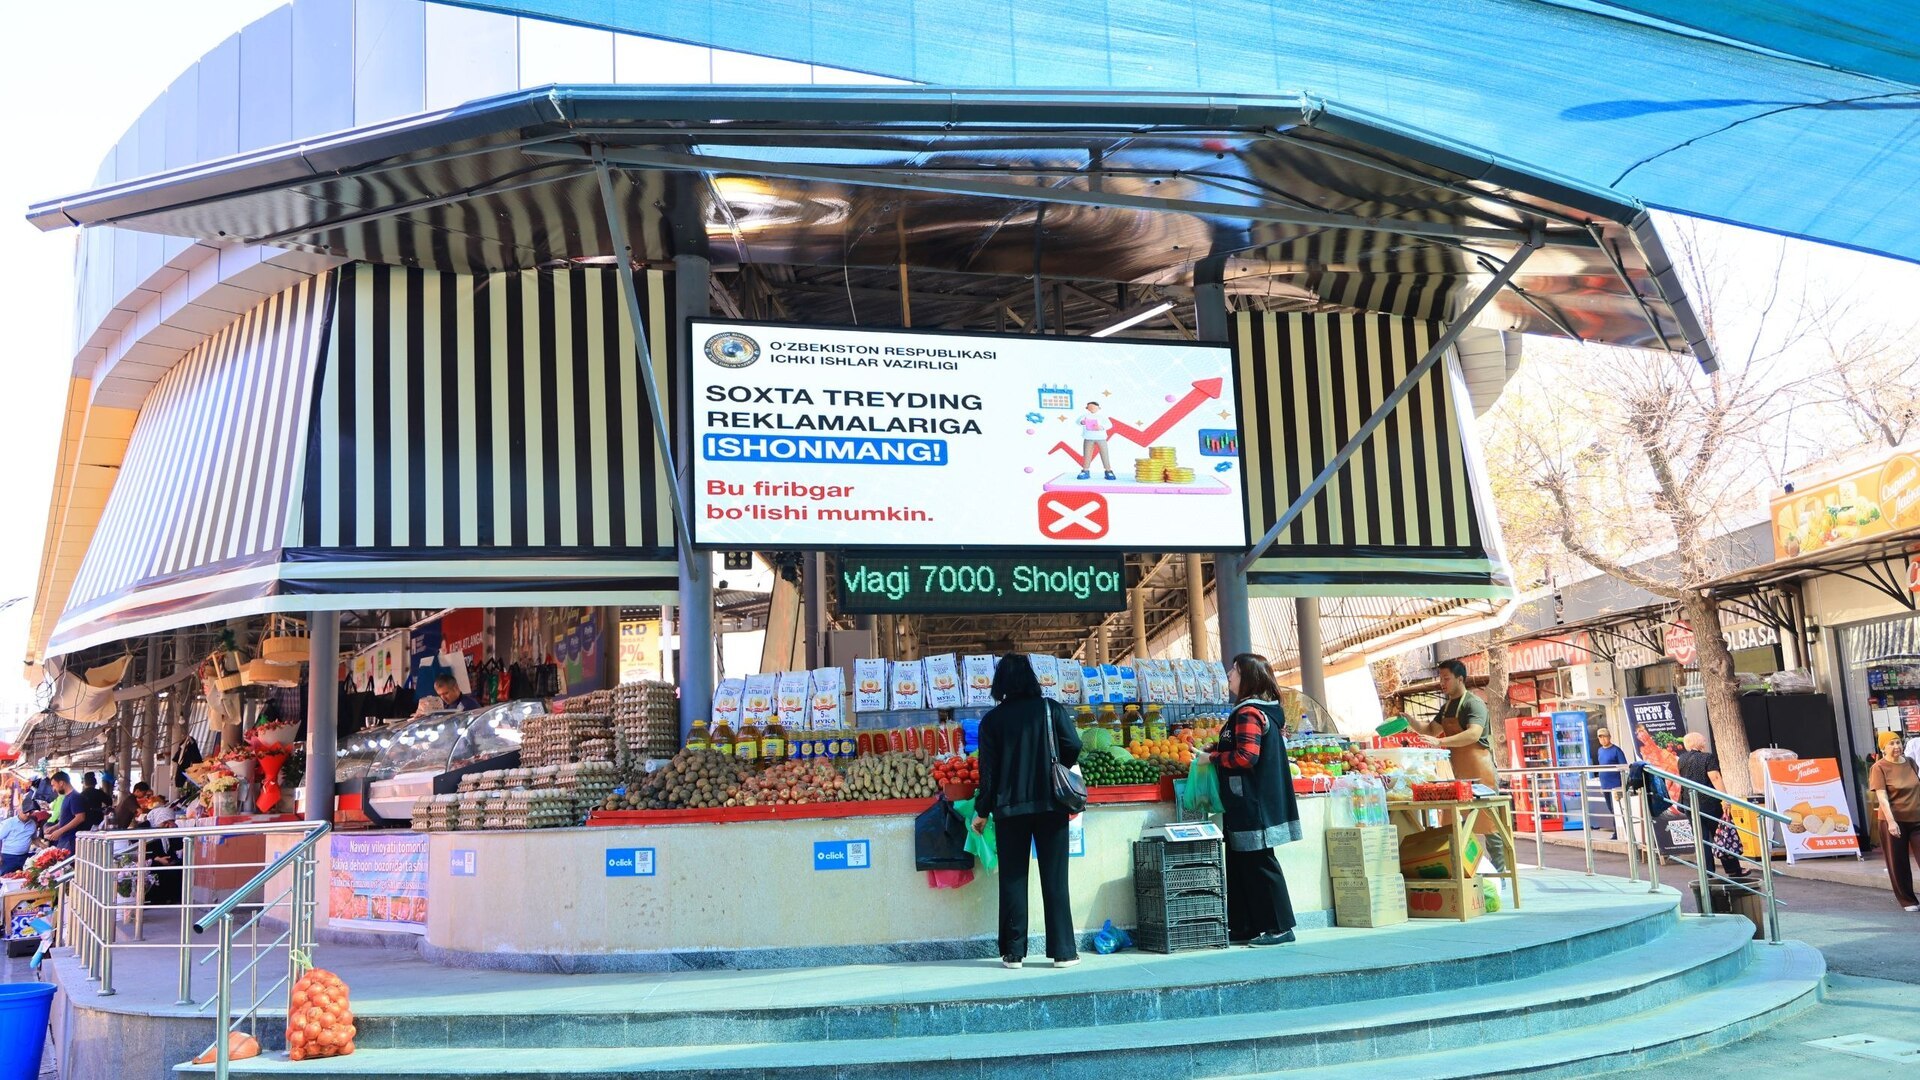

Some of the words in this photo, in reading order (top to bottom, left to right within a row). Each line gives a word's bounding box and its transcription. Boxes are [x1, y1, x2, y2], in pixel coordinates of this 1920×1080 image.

[884, 346, 997, 360] RESPUBLIKASI
[770, 354, 815, 365] ICHKI
[820, 356, 879, 367] ISHLAR
[883, 359, 958, 371] VAZIRLIGI
[705, 385, 815, 405] SOXTA
[823, 389, 983, 411] TREYDING
[707, 410, 983, 435] REKLAMALARIGA
[707, 436, 941, 462] ISHONMANG!
[706, 479, 744, 496] Bu
[753, 480, 855, 501] firibgar
[706, 503, 808, 520] bo‘lishi
[817, 506, 934, 521] mumkin.
[844, 565, 911, 600] vlagi
[919, 565, 1004, 597] 7000,
[1721, 625, 1779, 652] OLBASA
[1634, 705, 1662, 715] KOPCHU
[1635, 712, 1664, 722] RIBOV
[350, 840, 370, 855] Navoiy
[372, 840, 396, 855] viloyati
[825, 851, 845, 860] click
[615, 858, 633, 866] click
